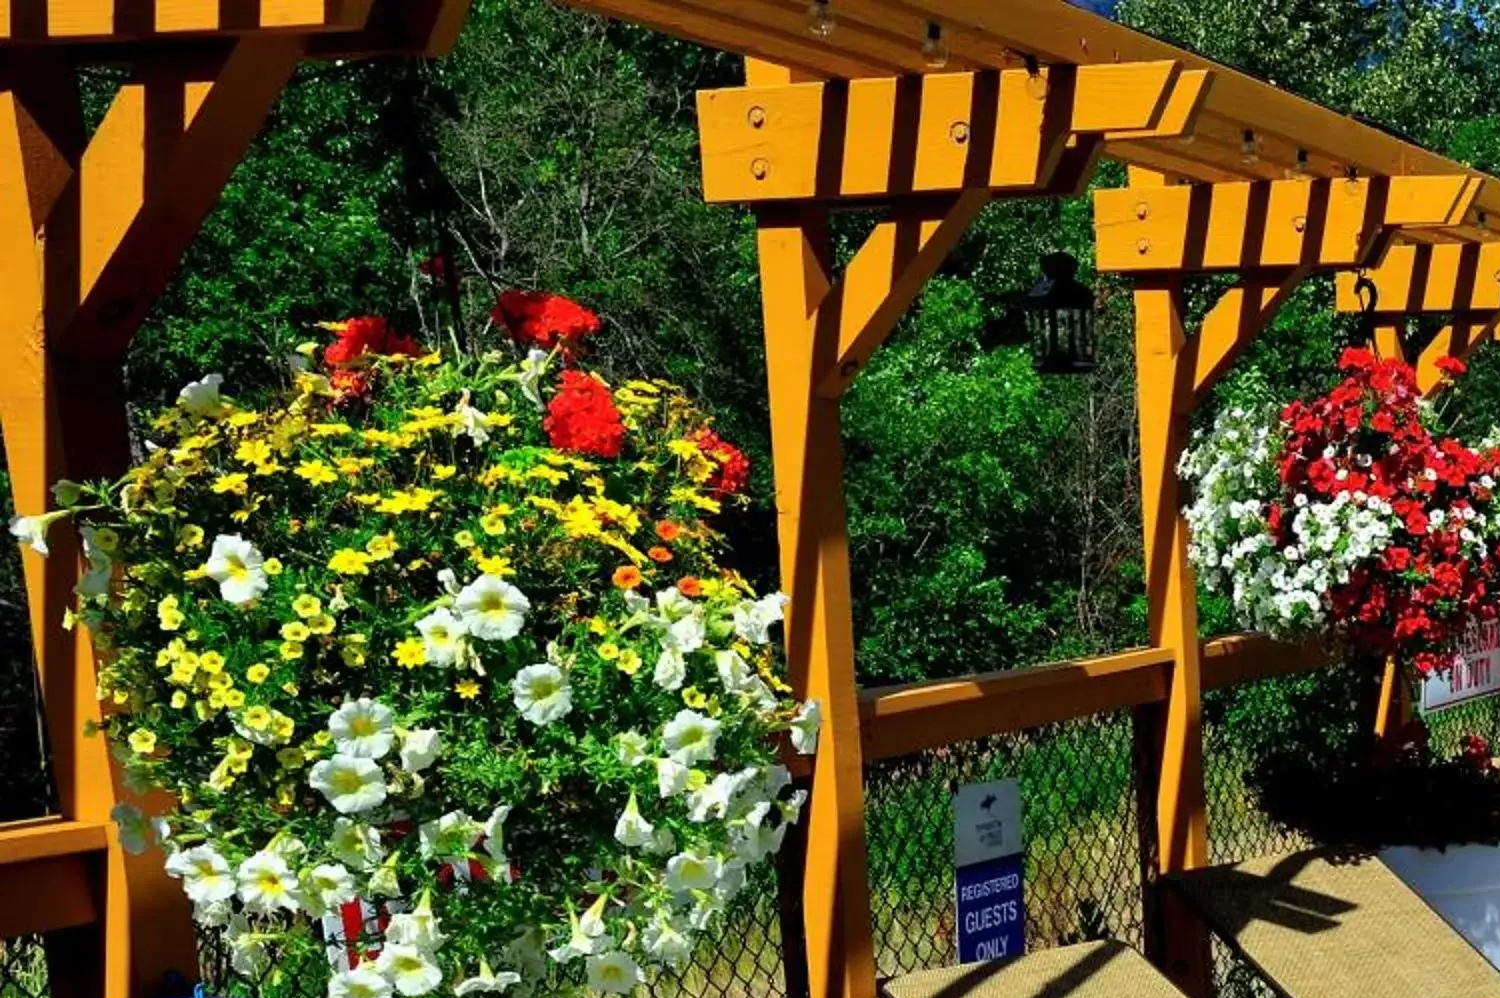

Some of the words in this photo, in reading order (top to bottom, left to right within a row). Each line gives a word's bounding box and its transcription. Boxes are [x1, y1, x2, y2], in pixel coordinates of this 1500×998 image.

[1467, 658, 1490, 688] DUTY
[961, 873, 1019, 902] REGISTERED
[965, 900, 1017, 934] GUESTS
[976, 934, 1009, 961] ONLY
